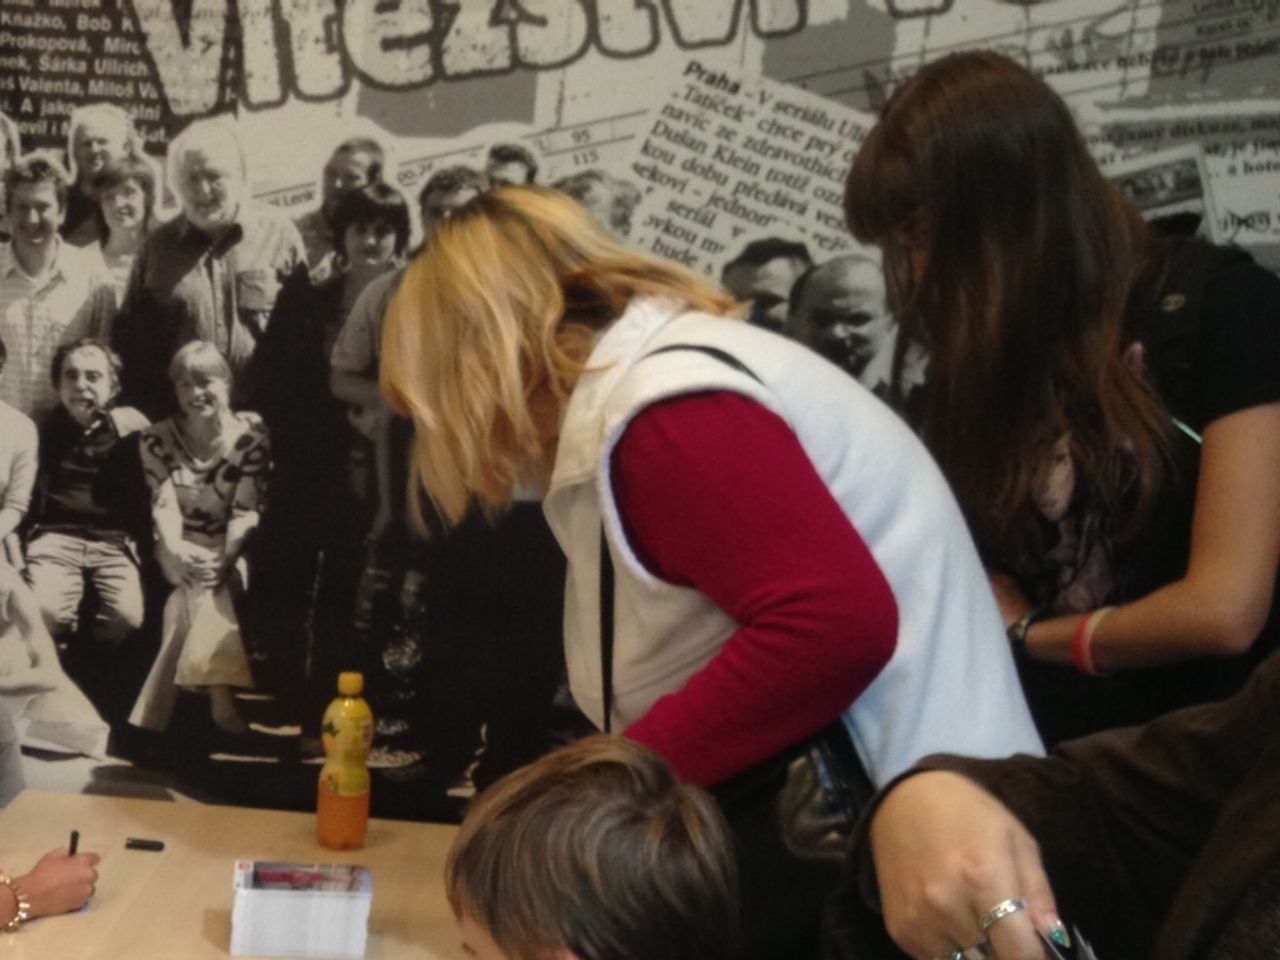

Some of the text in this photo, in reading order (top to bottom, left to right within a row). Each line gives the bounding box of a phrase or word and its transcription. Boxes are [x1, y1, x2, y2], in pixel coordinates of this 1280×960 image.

[76, 13, 112, 31] Bob
[683, 60, 741, 95] Praha
[772, 100, 836, 132] seriálu
[660, 103, 711, 132] navíc
[715, 125, 738, 142] ze
[757, 117, 804, 143] chce
[640, 138, 676, 166] kou
[680, 157, 730, 187] dobu
[650, 120, 708, 154] Dušan
[712, 144, 761, 177] Klein
[651, 236, 699, 268] bude
